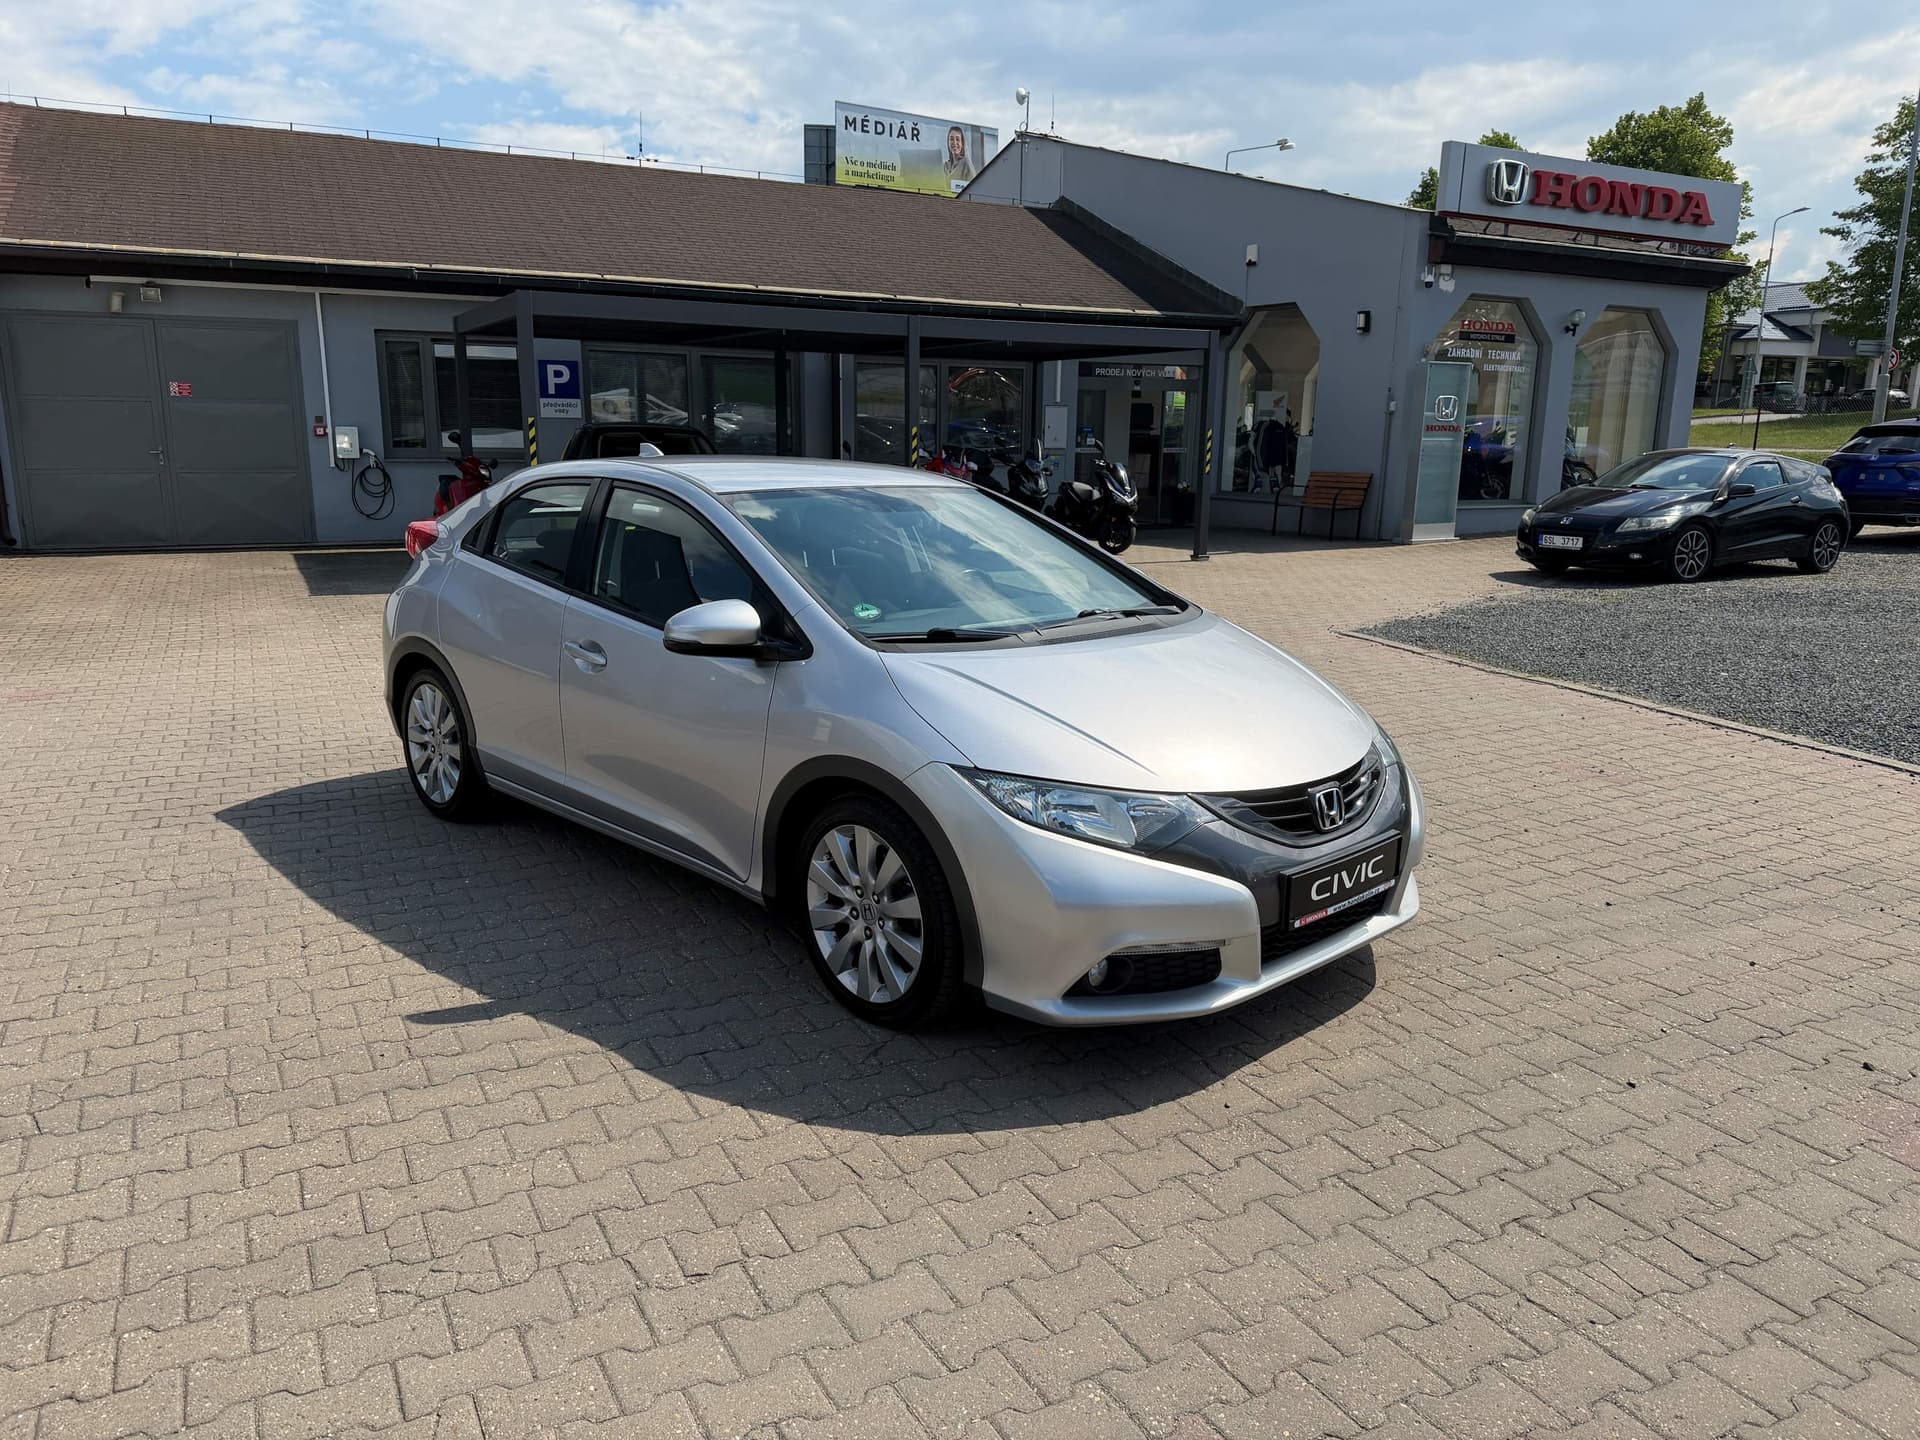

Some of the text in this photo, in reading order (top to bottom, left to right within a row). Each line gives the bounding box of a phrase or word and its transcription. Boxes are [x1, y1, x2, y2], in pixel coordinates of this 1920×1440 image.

[844, 114, 921, 142] MÉDIÁŘ
[851, 169, 895, 183] marketingu
[1532, 169, 1715, 226] HONDA
[1460, 320, 1516, 332] HONDA
[1447, 347, 1521, 361] ZAHRADNÍ TECHNIKA
[1095, 367, 1125, 377] PRODEJ
[1126, 367, 1156, 377] NOVÝCH
[546, 364, 570, 395] P
[1425, 424, 1462, 433] HONDA
[1544, 536, 1579, 546] 6SL 3717
[1311, 854, 1384, 901] CIVIC
[1305, 909, 1327, 922] HONDA
